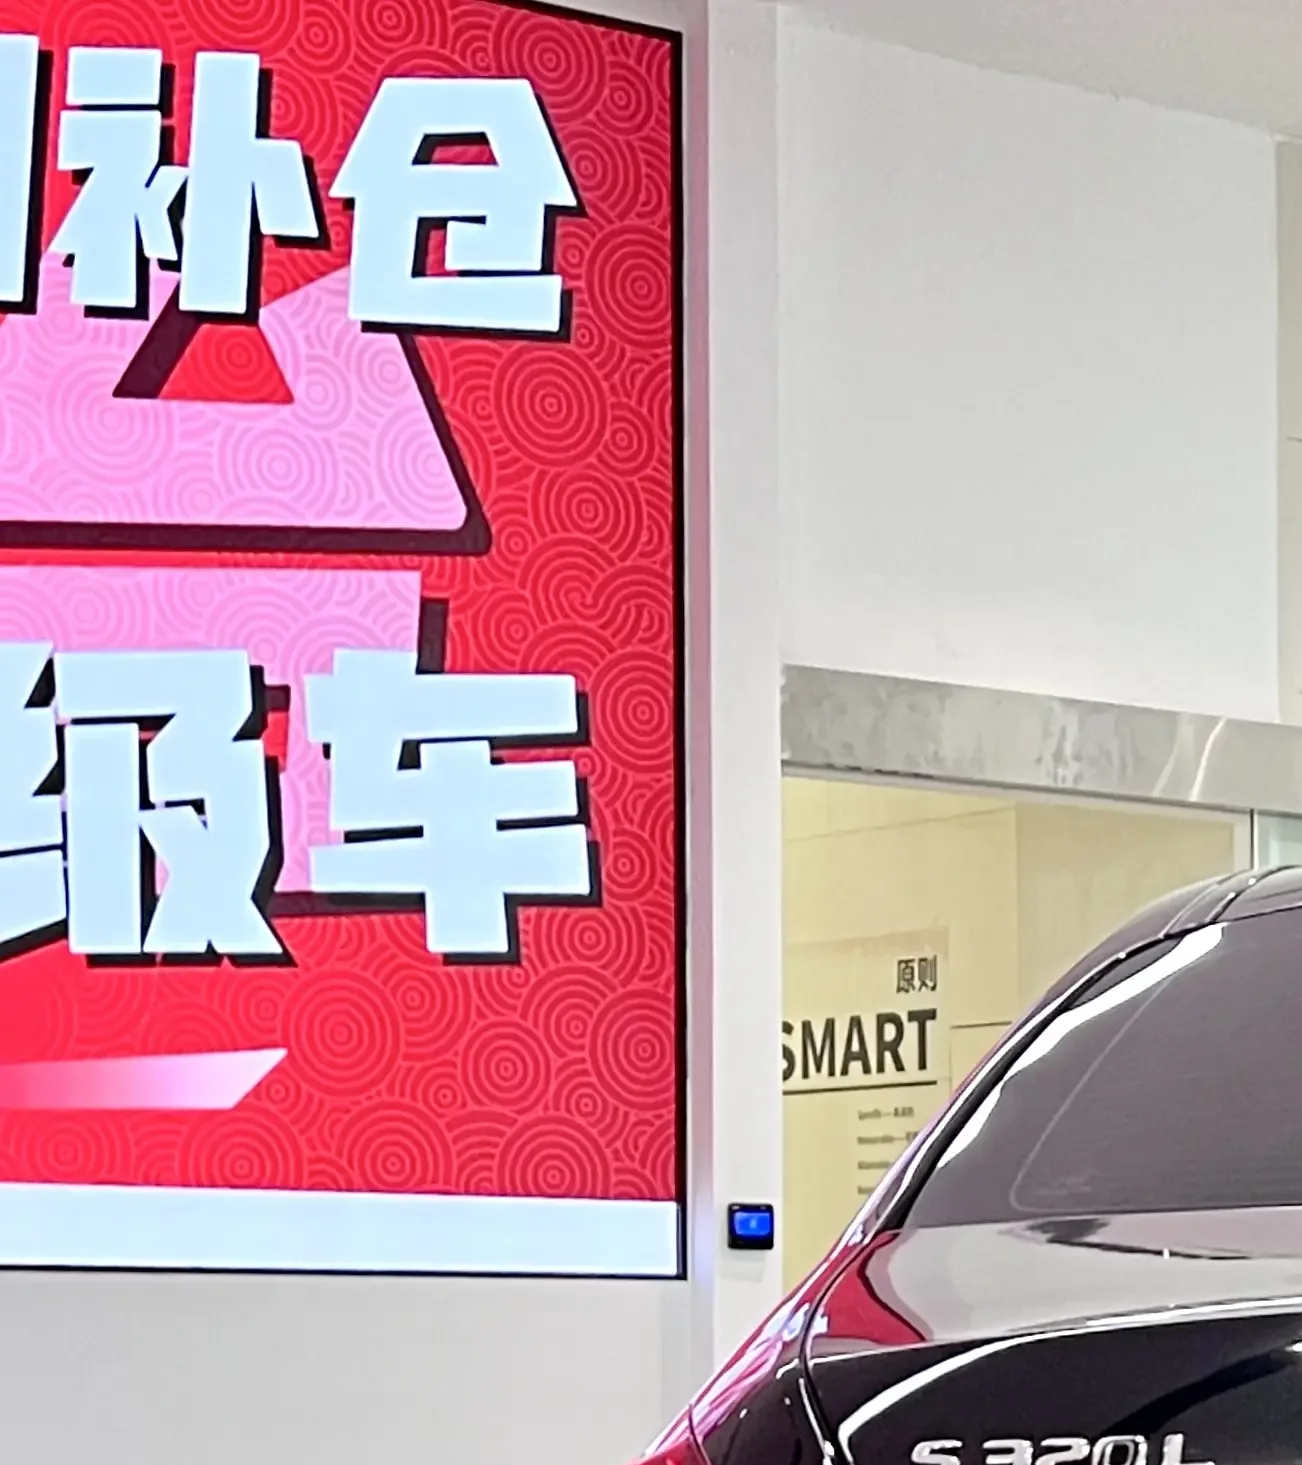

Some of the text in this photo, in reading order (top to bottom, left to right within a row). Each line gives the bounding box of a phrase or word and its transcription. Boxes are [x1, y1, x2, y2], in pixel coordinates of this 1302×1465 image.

[0, 640, 591, 955] 级车
[896, 954, 938, 993] 原则
[782, 1007, 938, 1082] SMART
